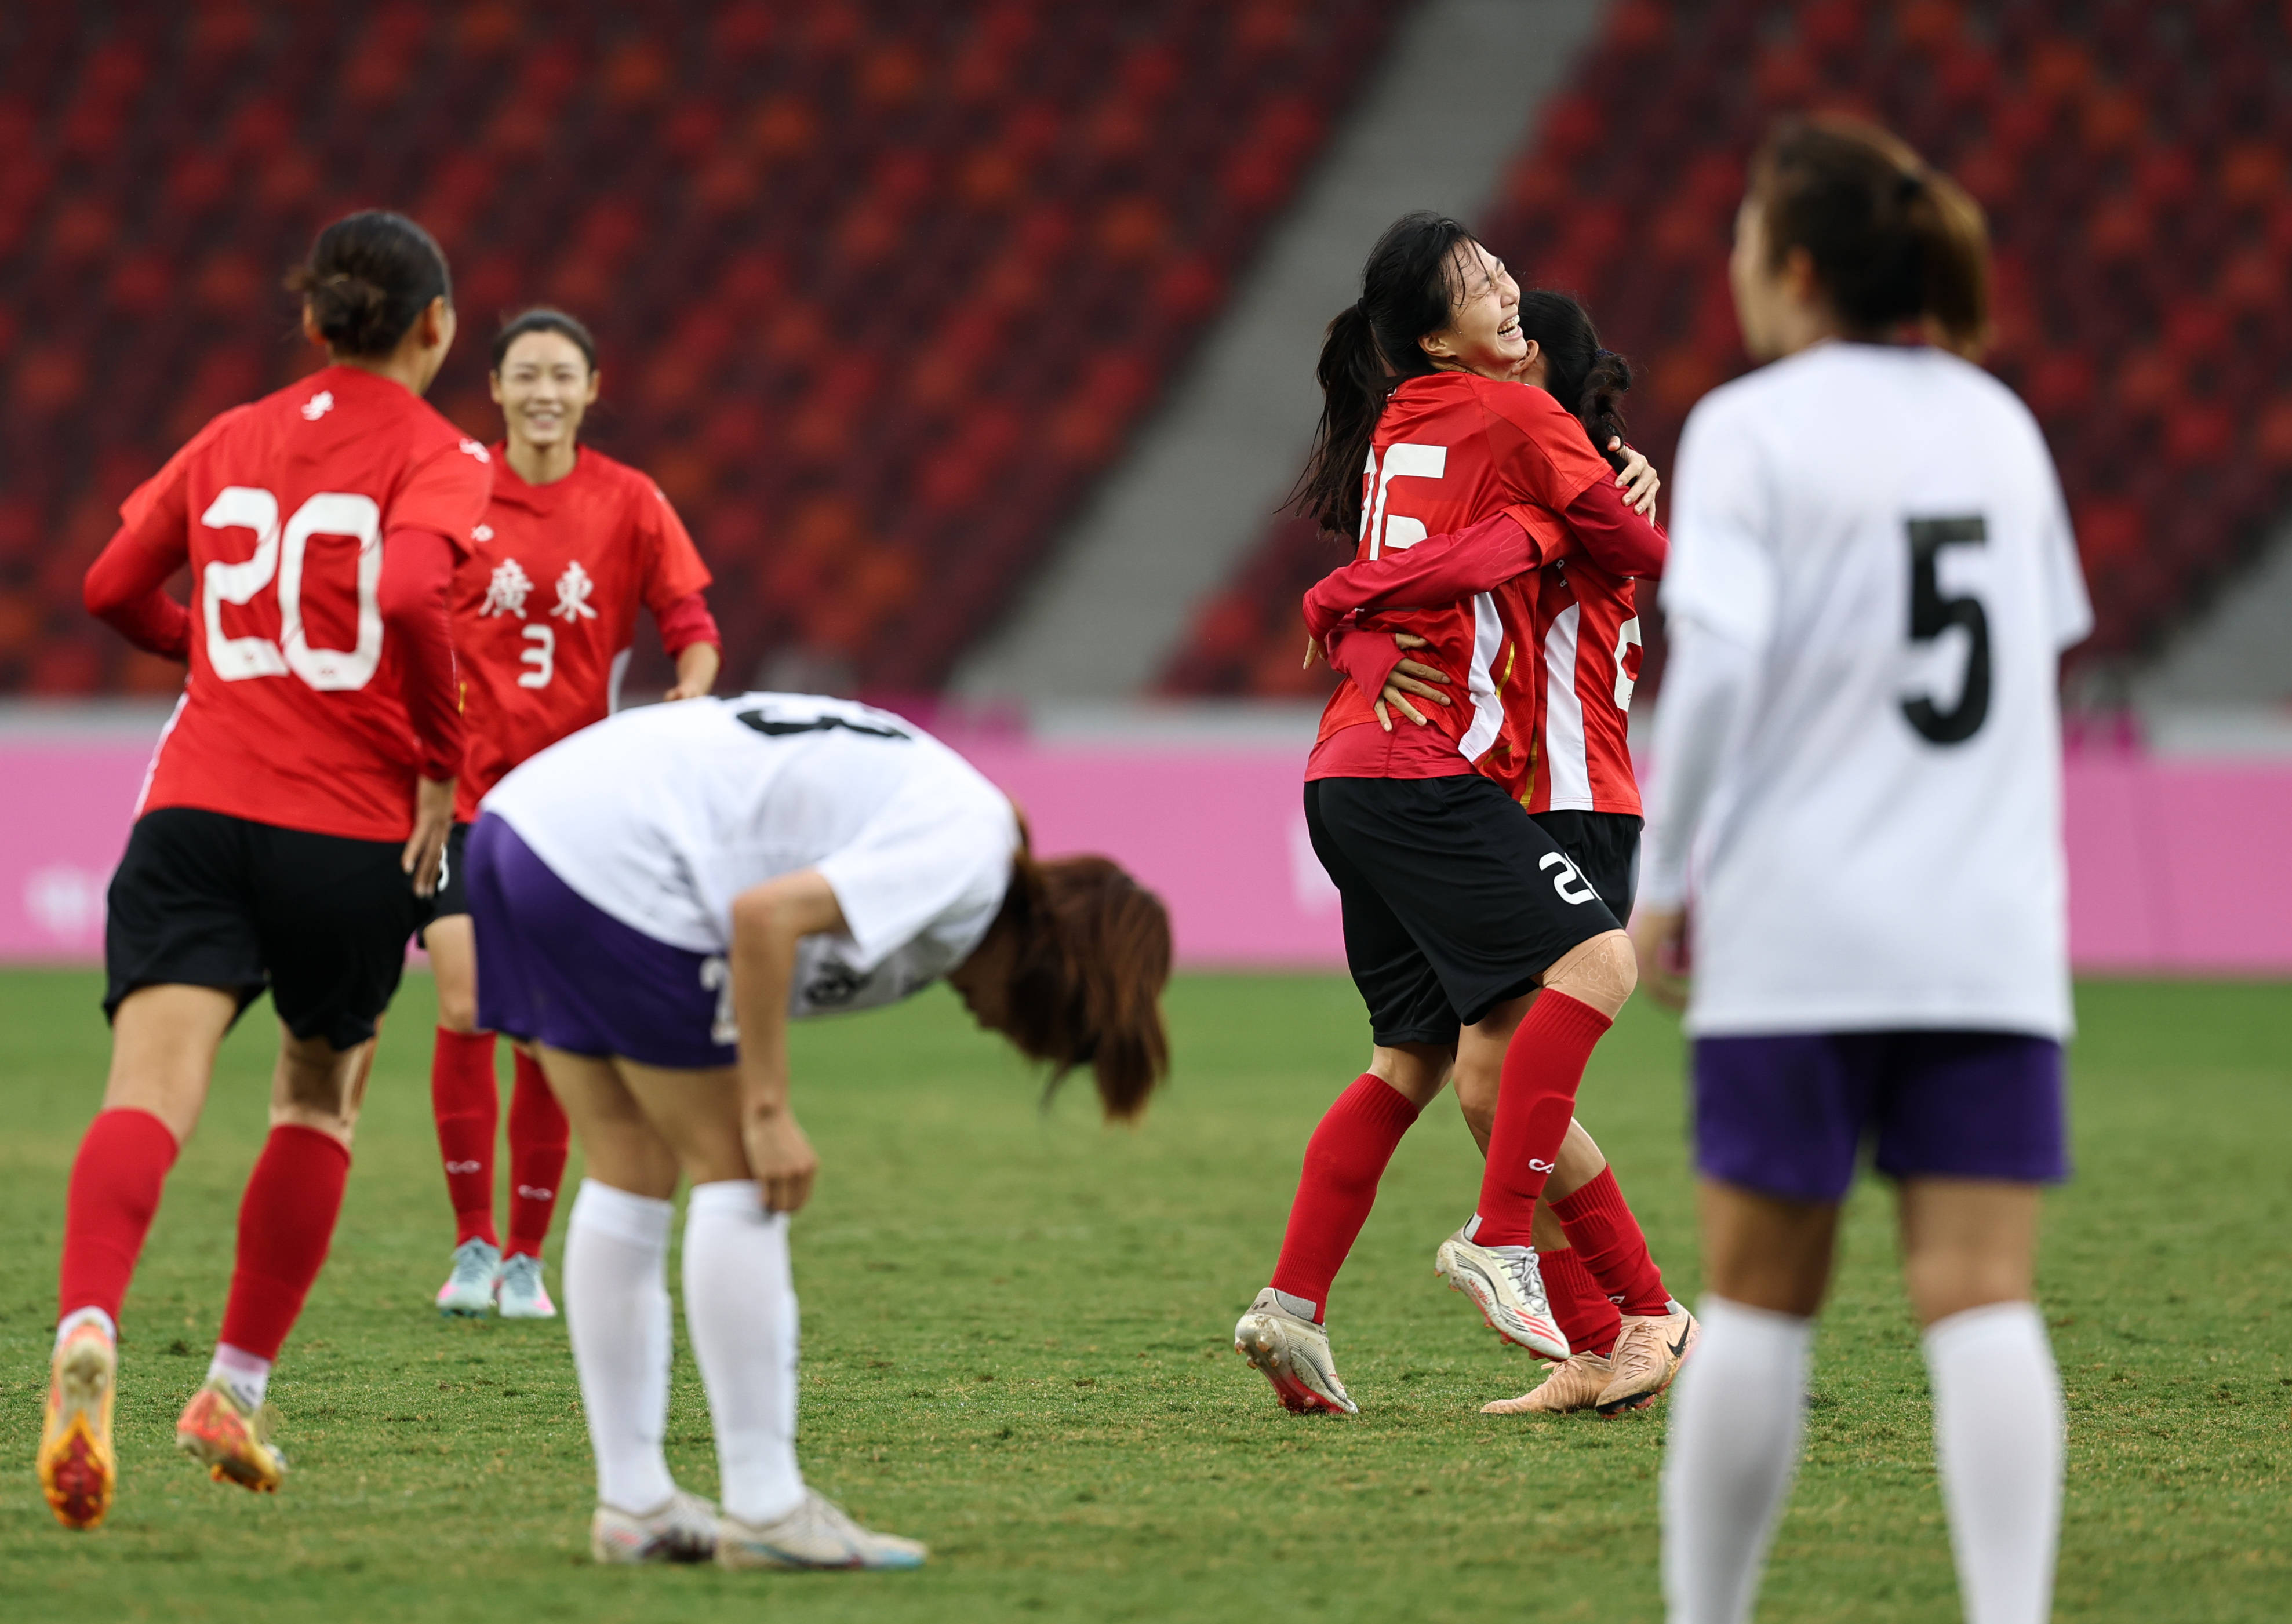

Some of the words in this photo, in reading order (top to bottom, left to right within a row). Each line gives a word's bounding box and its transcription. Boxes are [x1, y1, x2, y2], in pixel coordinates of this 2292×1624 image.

[202, 486, 384, 691] 20
[479, 558, 598, 623] 廣東
[518, 624, 555, 689] 3
[1902, 516, 1991, 744] 5
[1539, 851, 1603, 905] 2
